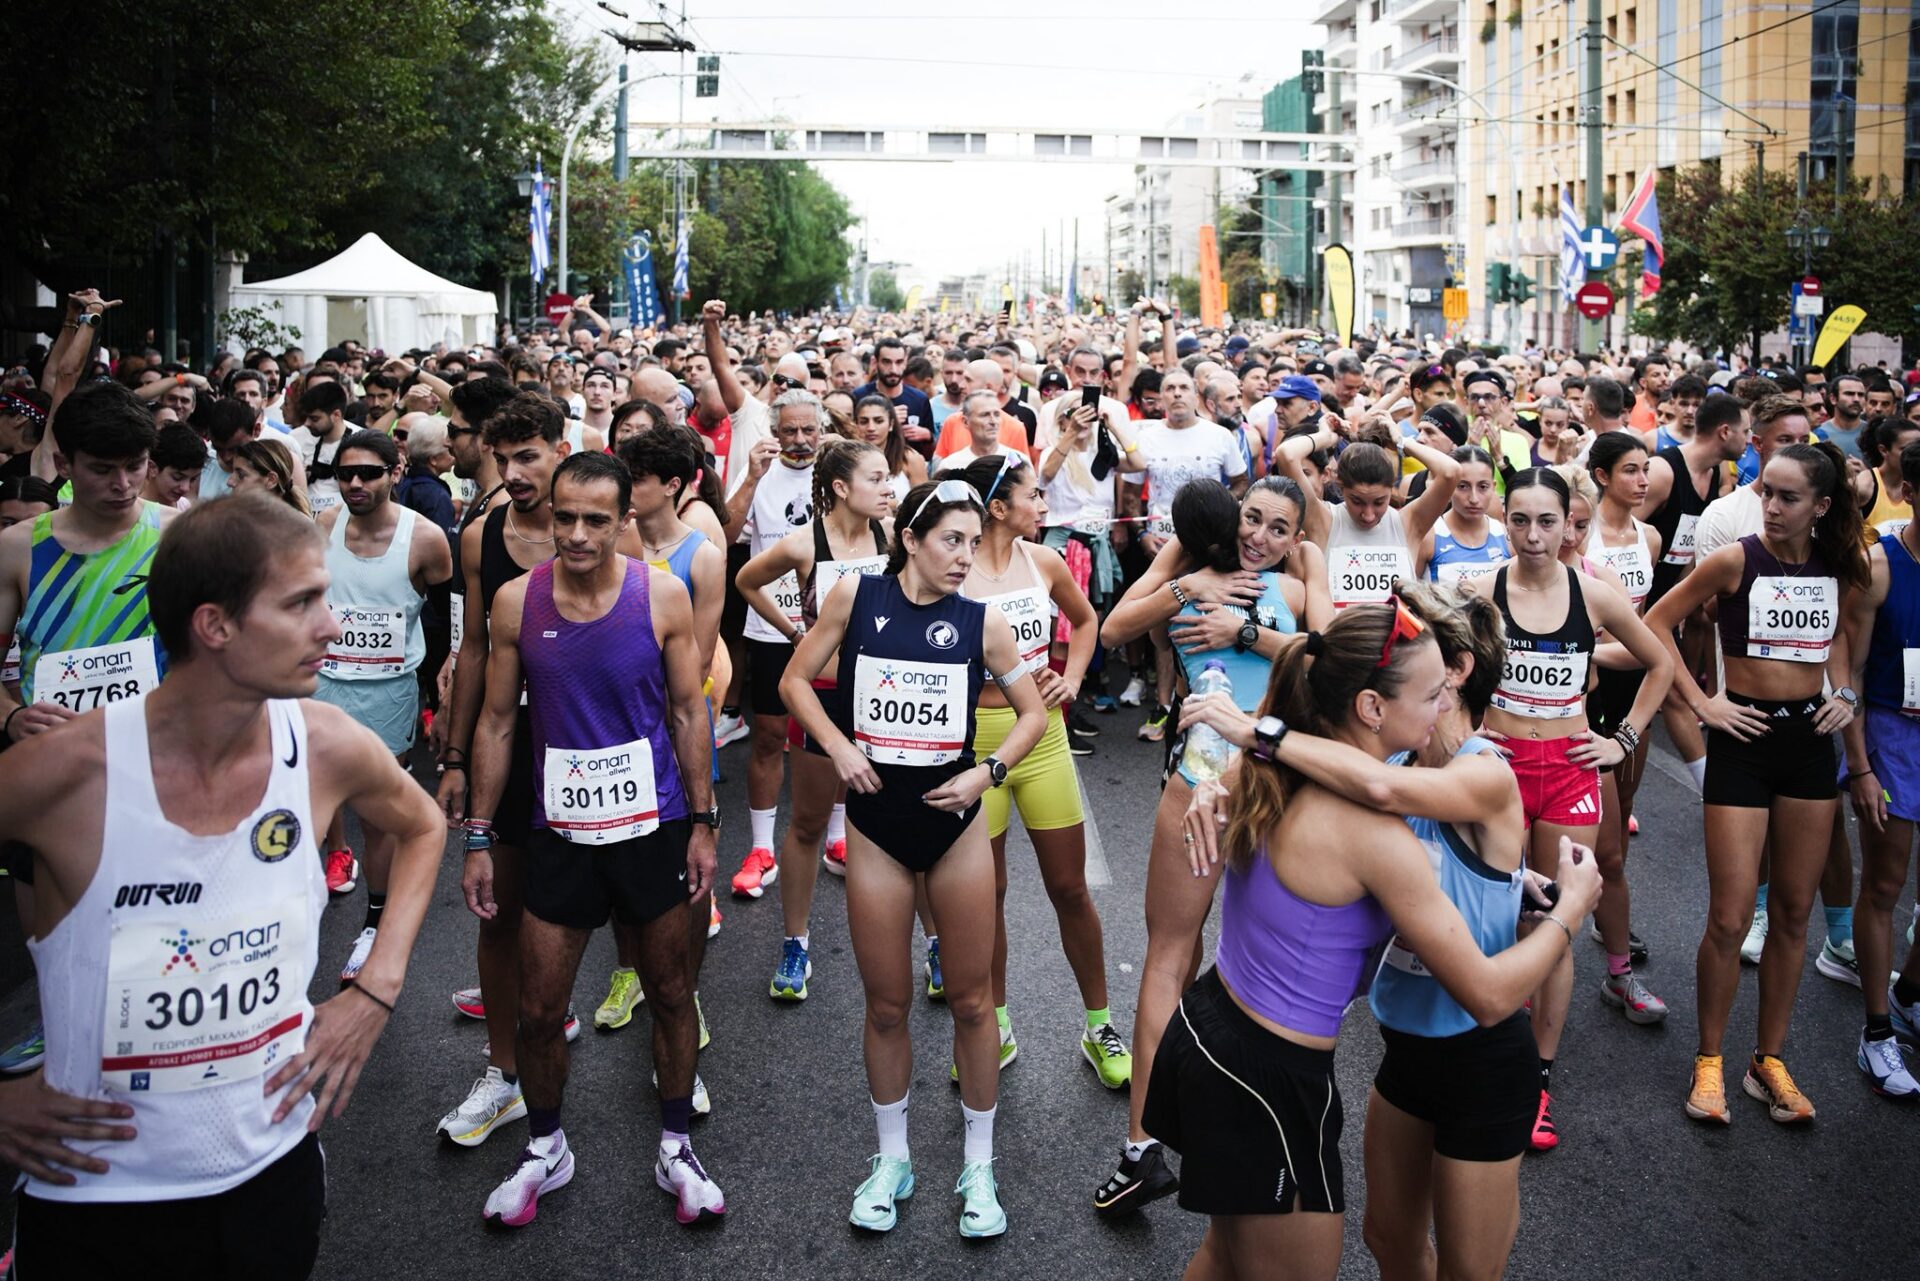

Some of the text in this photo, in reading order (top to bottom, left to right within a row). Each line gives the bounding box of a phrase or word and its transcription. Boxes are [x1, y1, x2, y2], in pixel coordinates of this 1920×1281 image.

[1766, 609, 1830, 629] 30065
[106, 665, 133, 676] allwyn
[1502, 662, 1573, 686] 30062
[52, 679, 141, 713] 37768
[922, 686, 946, 696] allwyn
[868, 698, 949, 726] 30054
[608, 766, 631, 776] allwyn
[561, 780, 638, 809] 30119
[114, 882, 203, 908] OUTRUN
[244, 944, 279, 963] allwyn
[144, 966, 281, 1031] 30103
[120, 998, 130, 1030] BLOCK
